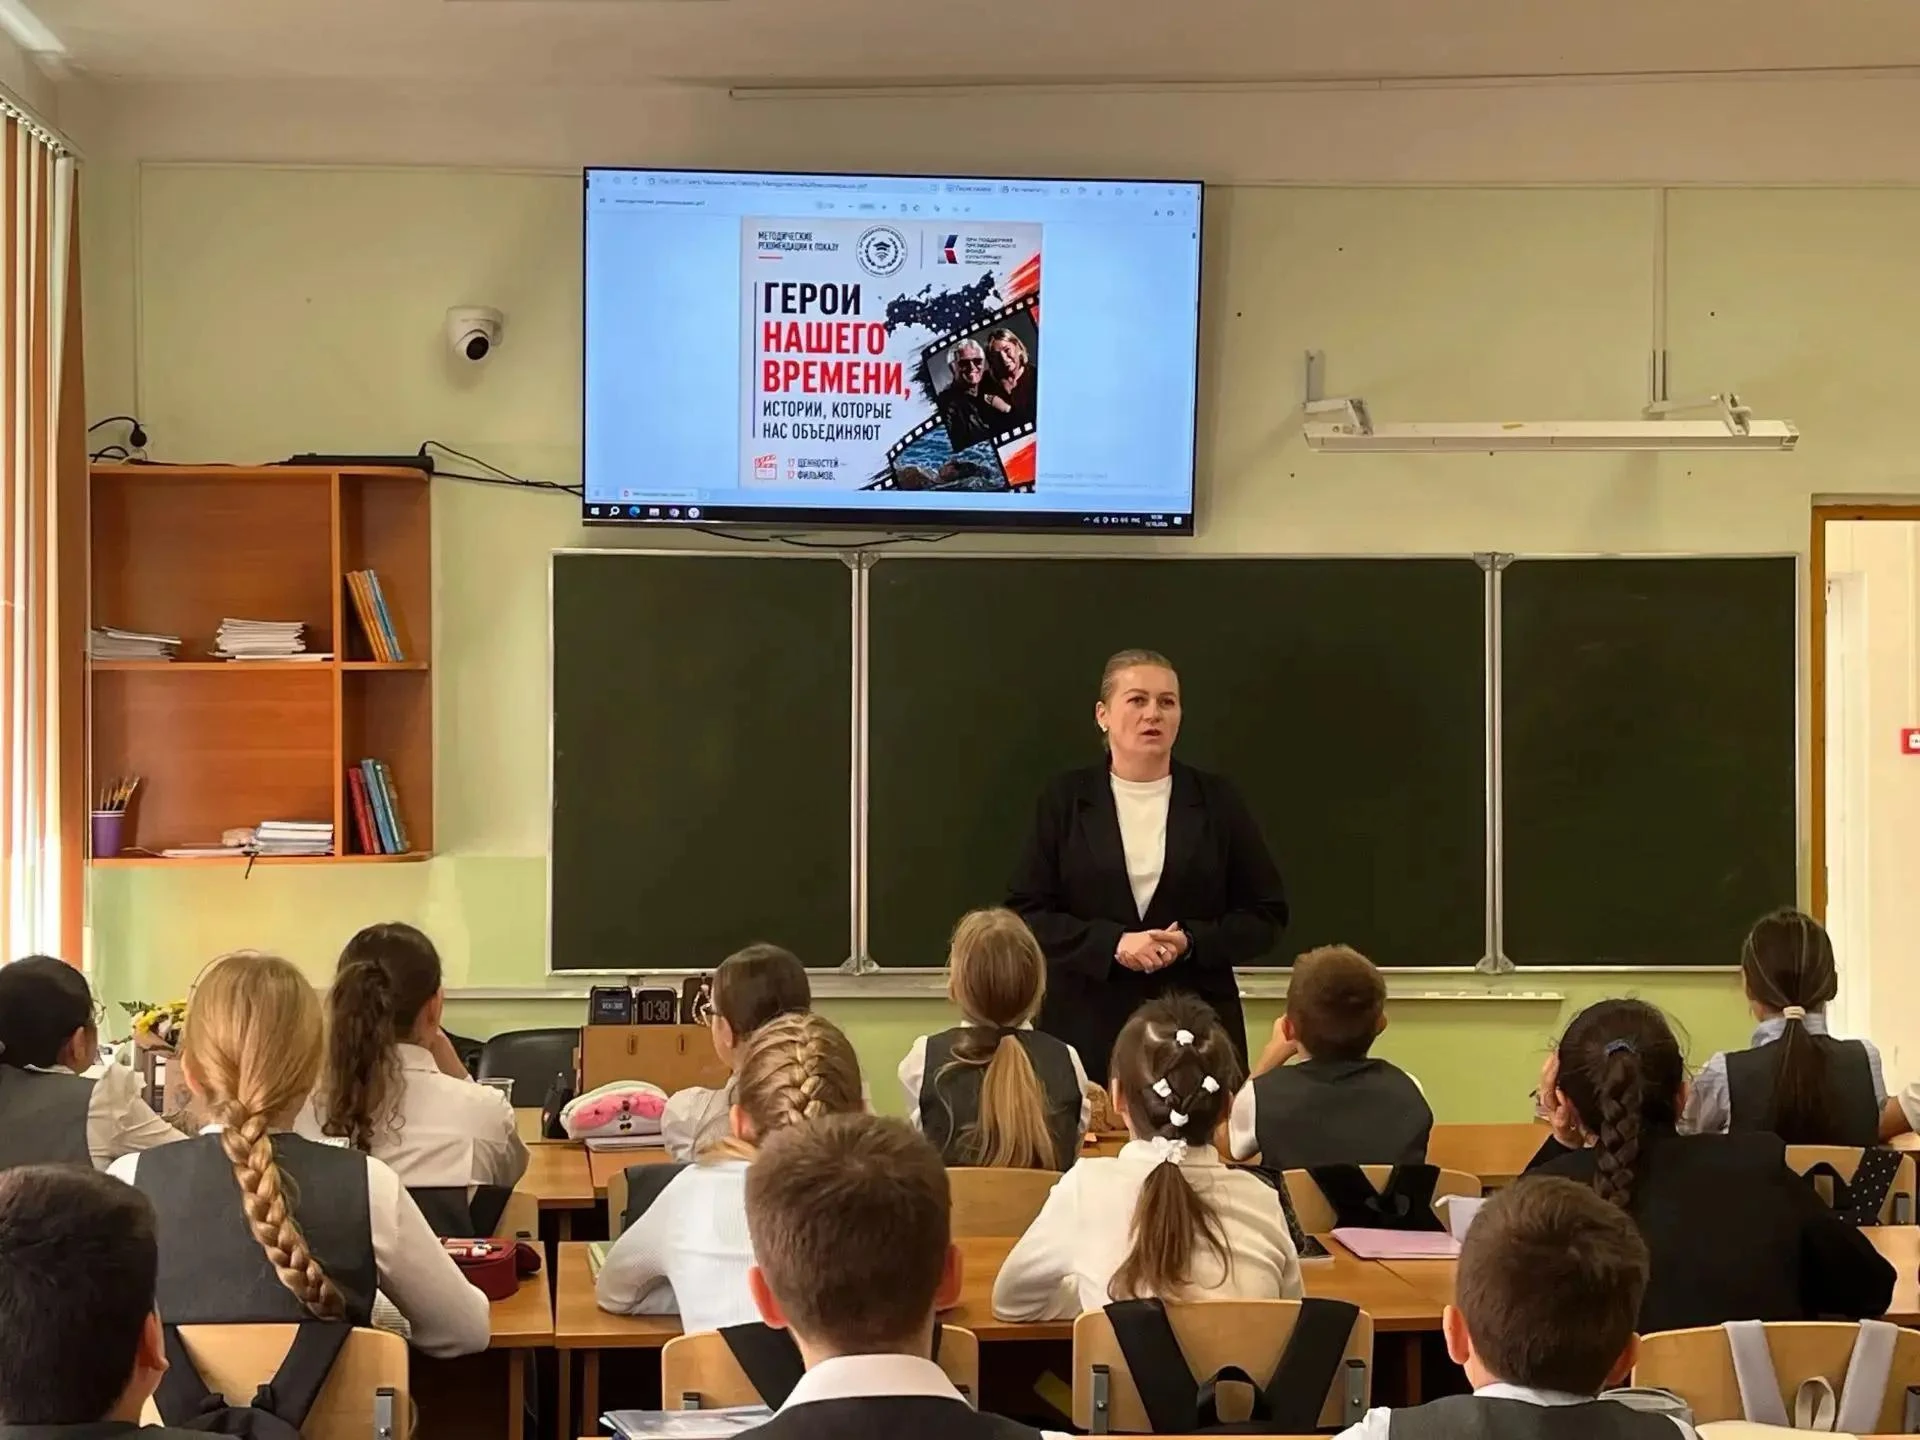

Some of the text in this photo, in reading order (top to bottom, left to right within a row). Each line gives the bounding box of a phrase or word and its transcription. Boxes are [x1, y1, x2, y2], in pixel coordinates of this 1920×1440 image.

[758, 231, 813, 241] МЕТОДИЧЕСКИЕ
[764, 282, 861, 315] ГЕРОИ
[763, 321, 885, 355] НАШЕГО
[763, 360, 911, 400] ВРЕМЕНИ,
[763, 400, 892, 420] ИСТОРИИ, КОТОРЫЕ
[763, 423, 881, 442] НАС ОБЪЕДИНЯЮТ
